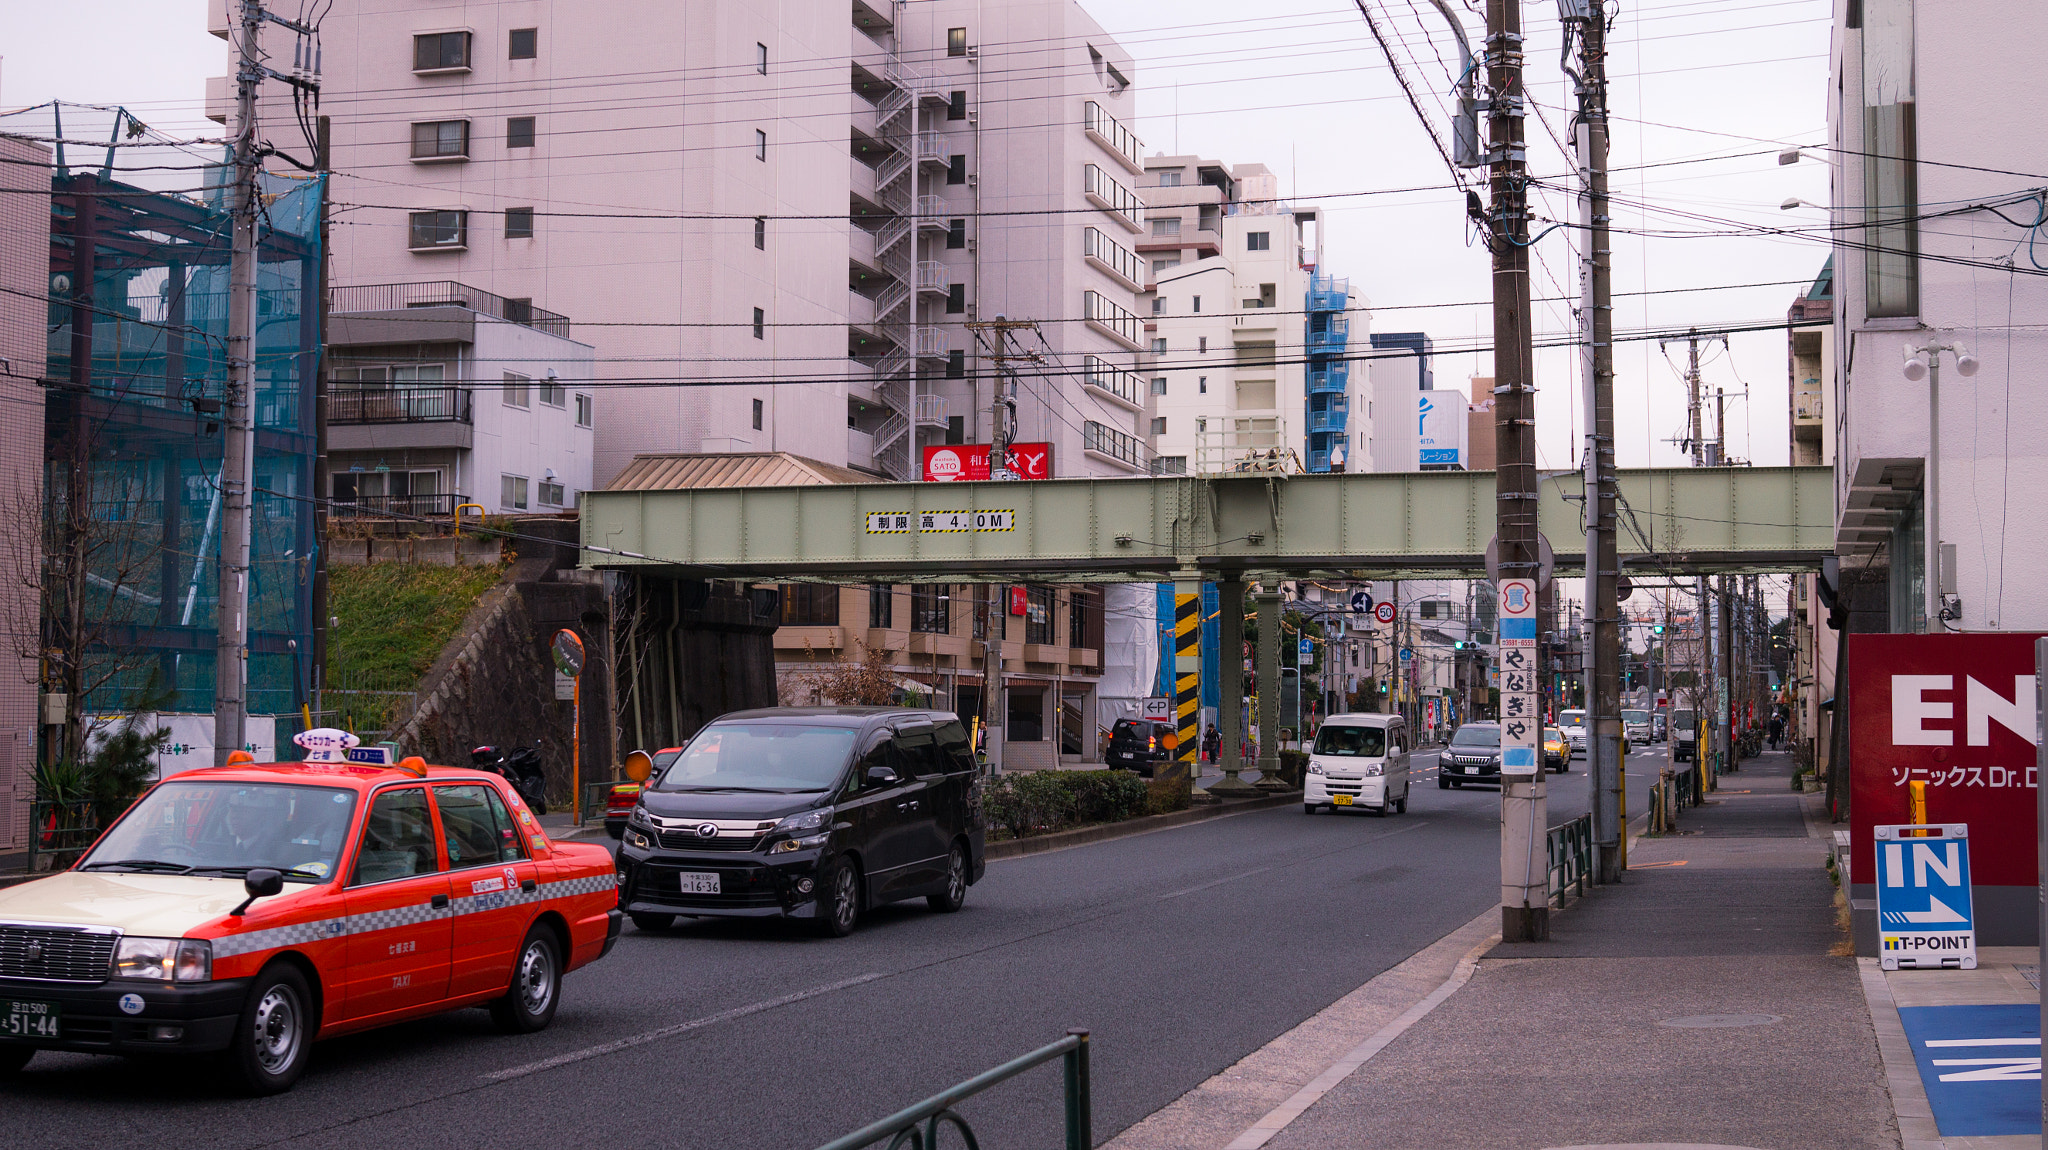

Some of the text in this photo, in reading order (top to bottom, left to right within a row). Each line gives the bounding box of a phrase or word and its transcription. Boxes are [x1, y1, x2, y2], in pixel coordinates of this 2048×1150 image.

[934, 463, 957, 471] SATO
[1508, 588, 1524, 607] 質
[1380, 608, 1392, 618] 50
[1506, 648, 1526, 740] やなぎや
[1157, 702, 1166, 713] P
[181, 744, 196, 755] 第一
[351, 751, 369, 760] iD
[1885, 842, 1961, 888] IN
[690, 881, 719, 893] 16-36
[392, 974, 411, 989] TAXI
[11, 1001, 48, 1014] 足立500
[10, 1014, 57, 1035] 51-44
